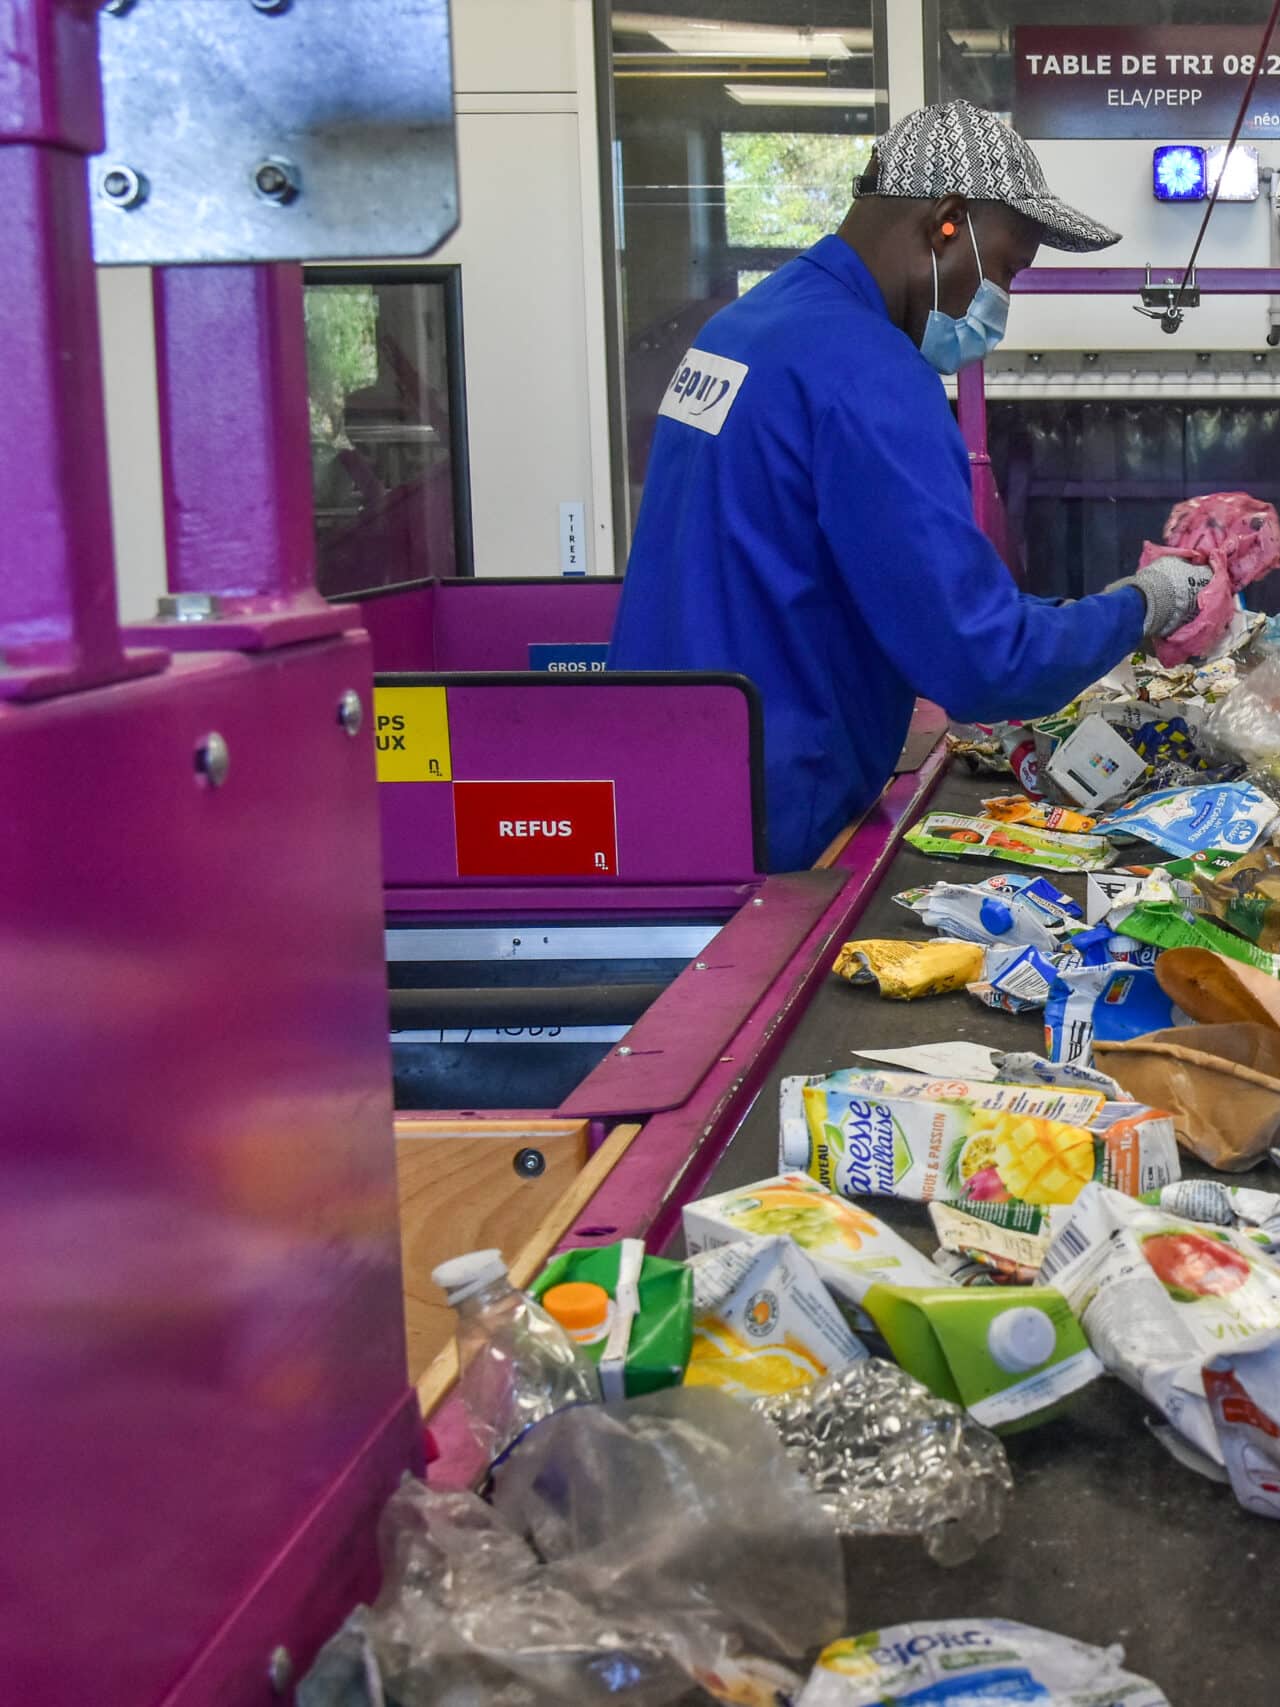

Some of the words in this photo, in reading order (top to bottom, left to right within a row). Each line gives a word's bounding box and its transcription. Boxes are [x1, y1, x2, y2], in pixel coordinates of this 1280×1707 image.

[1026, 55, 1111, 75] TABLE
[1121, 55, 1155, 75] DE
[1166, 55, 1213, 75] TRI
[1107, 88, 1202, 108] ELA/PEPP
[568, 513, 577, 564] TIREZ
[548, 662, 587, 672] GROS
[499, 820, 573, 838] REFUS
[928, 1112, 947, 1159] PASSION
[871, 1104, 895, 1196] ntillaise
